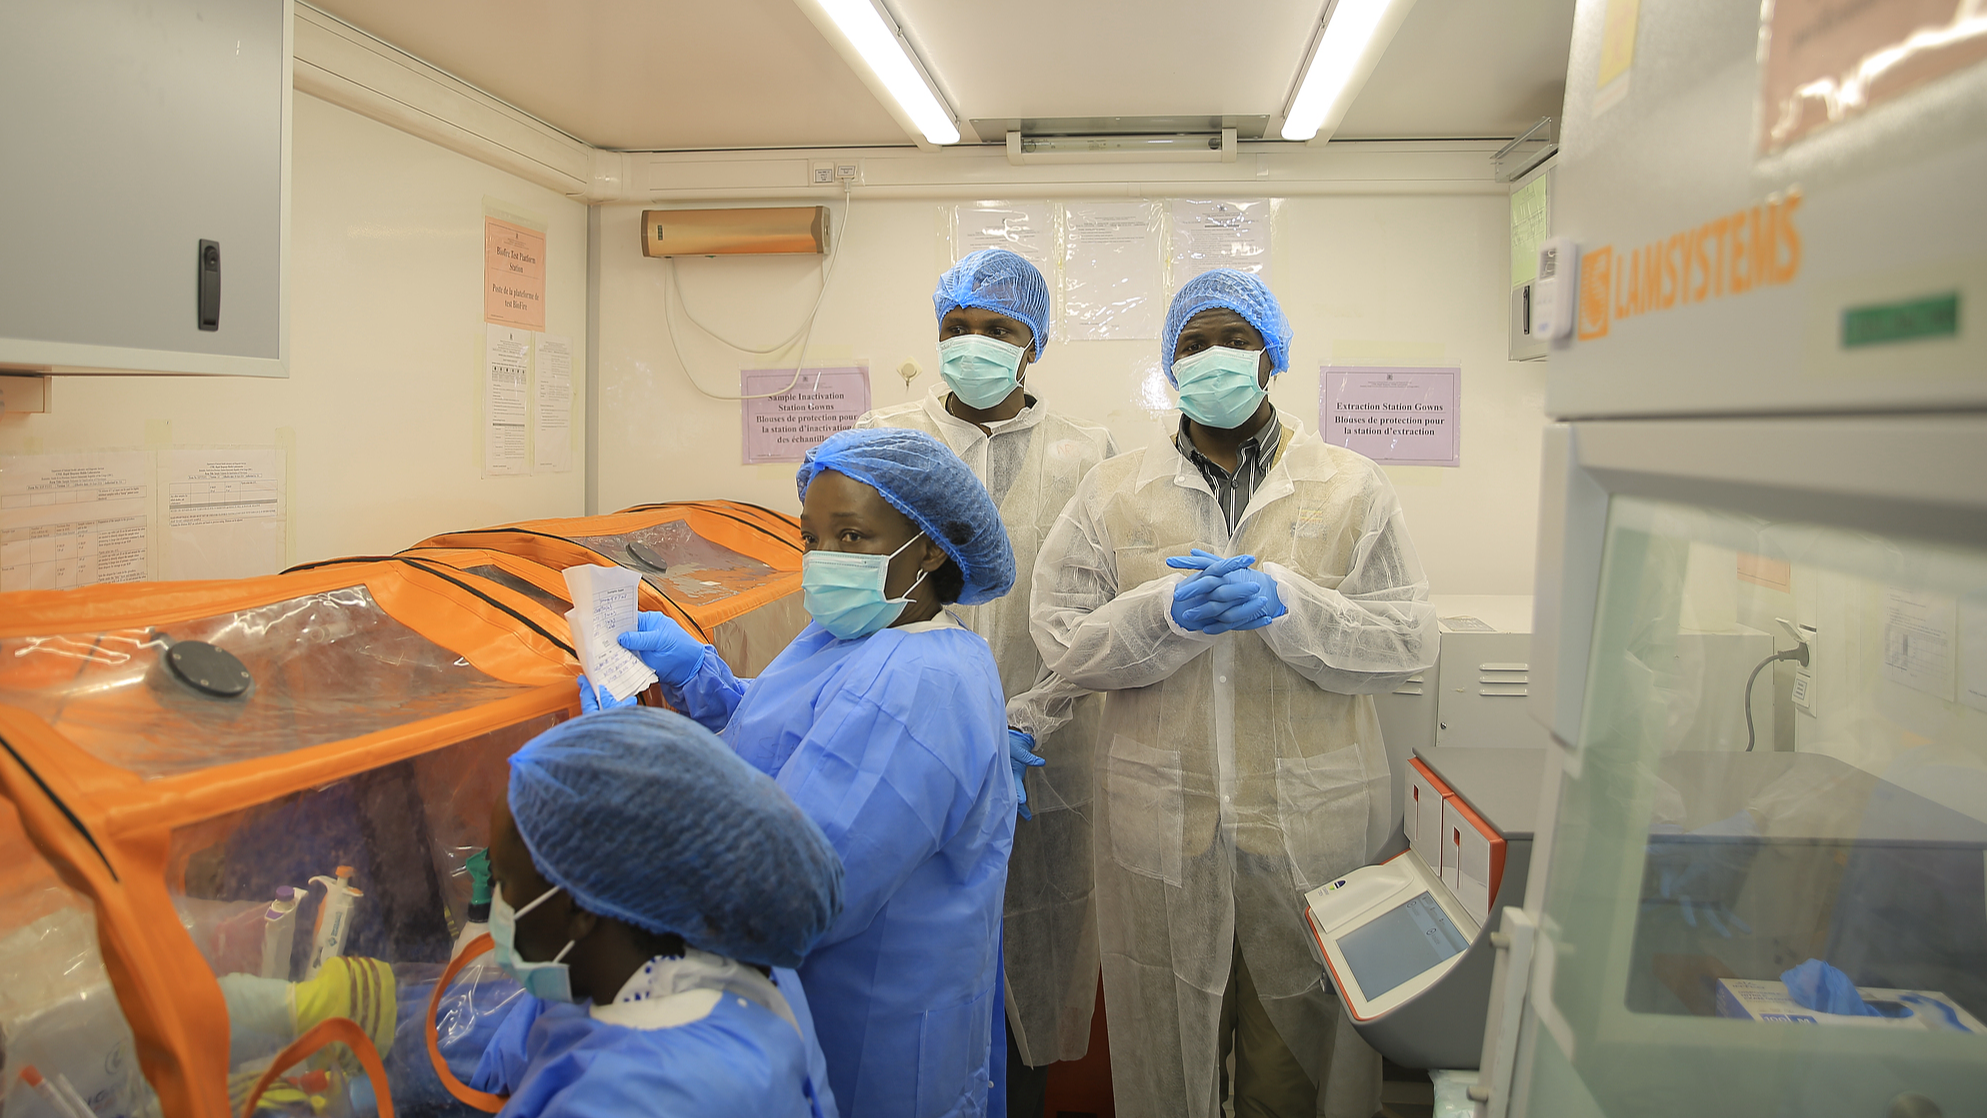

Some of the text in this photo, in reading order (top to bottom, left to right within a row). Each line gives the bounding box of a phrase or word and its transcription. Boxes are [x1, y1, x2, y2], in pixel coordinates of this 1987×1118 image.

[1614, 193, 1802, 320] LAMSYSTEMS
[767, 391, 845, 403] Sample Inactivation
[778, 403, 835, 412] Station Gowns
[1336, 402, 1444, 411] Extraction Station Gowns
[756, 413, 858, 424] Blouses de protection pour
[1334, 415, 1445, 427] Blouses de protection pour
[771, 425, 797, 433] station
[1343, 427, 1435, 436] la station d'extraction
[777, 435, 828, 444] des échantill
